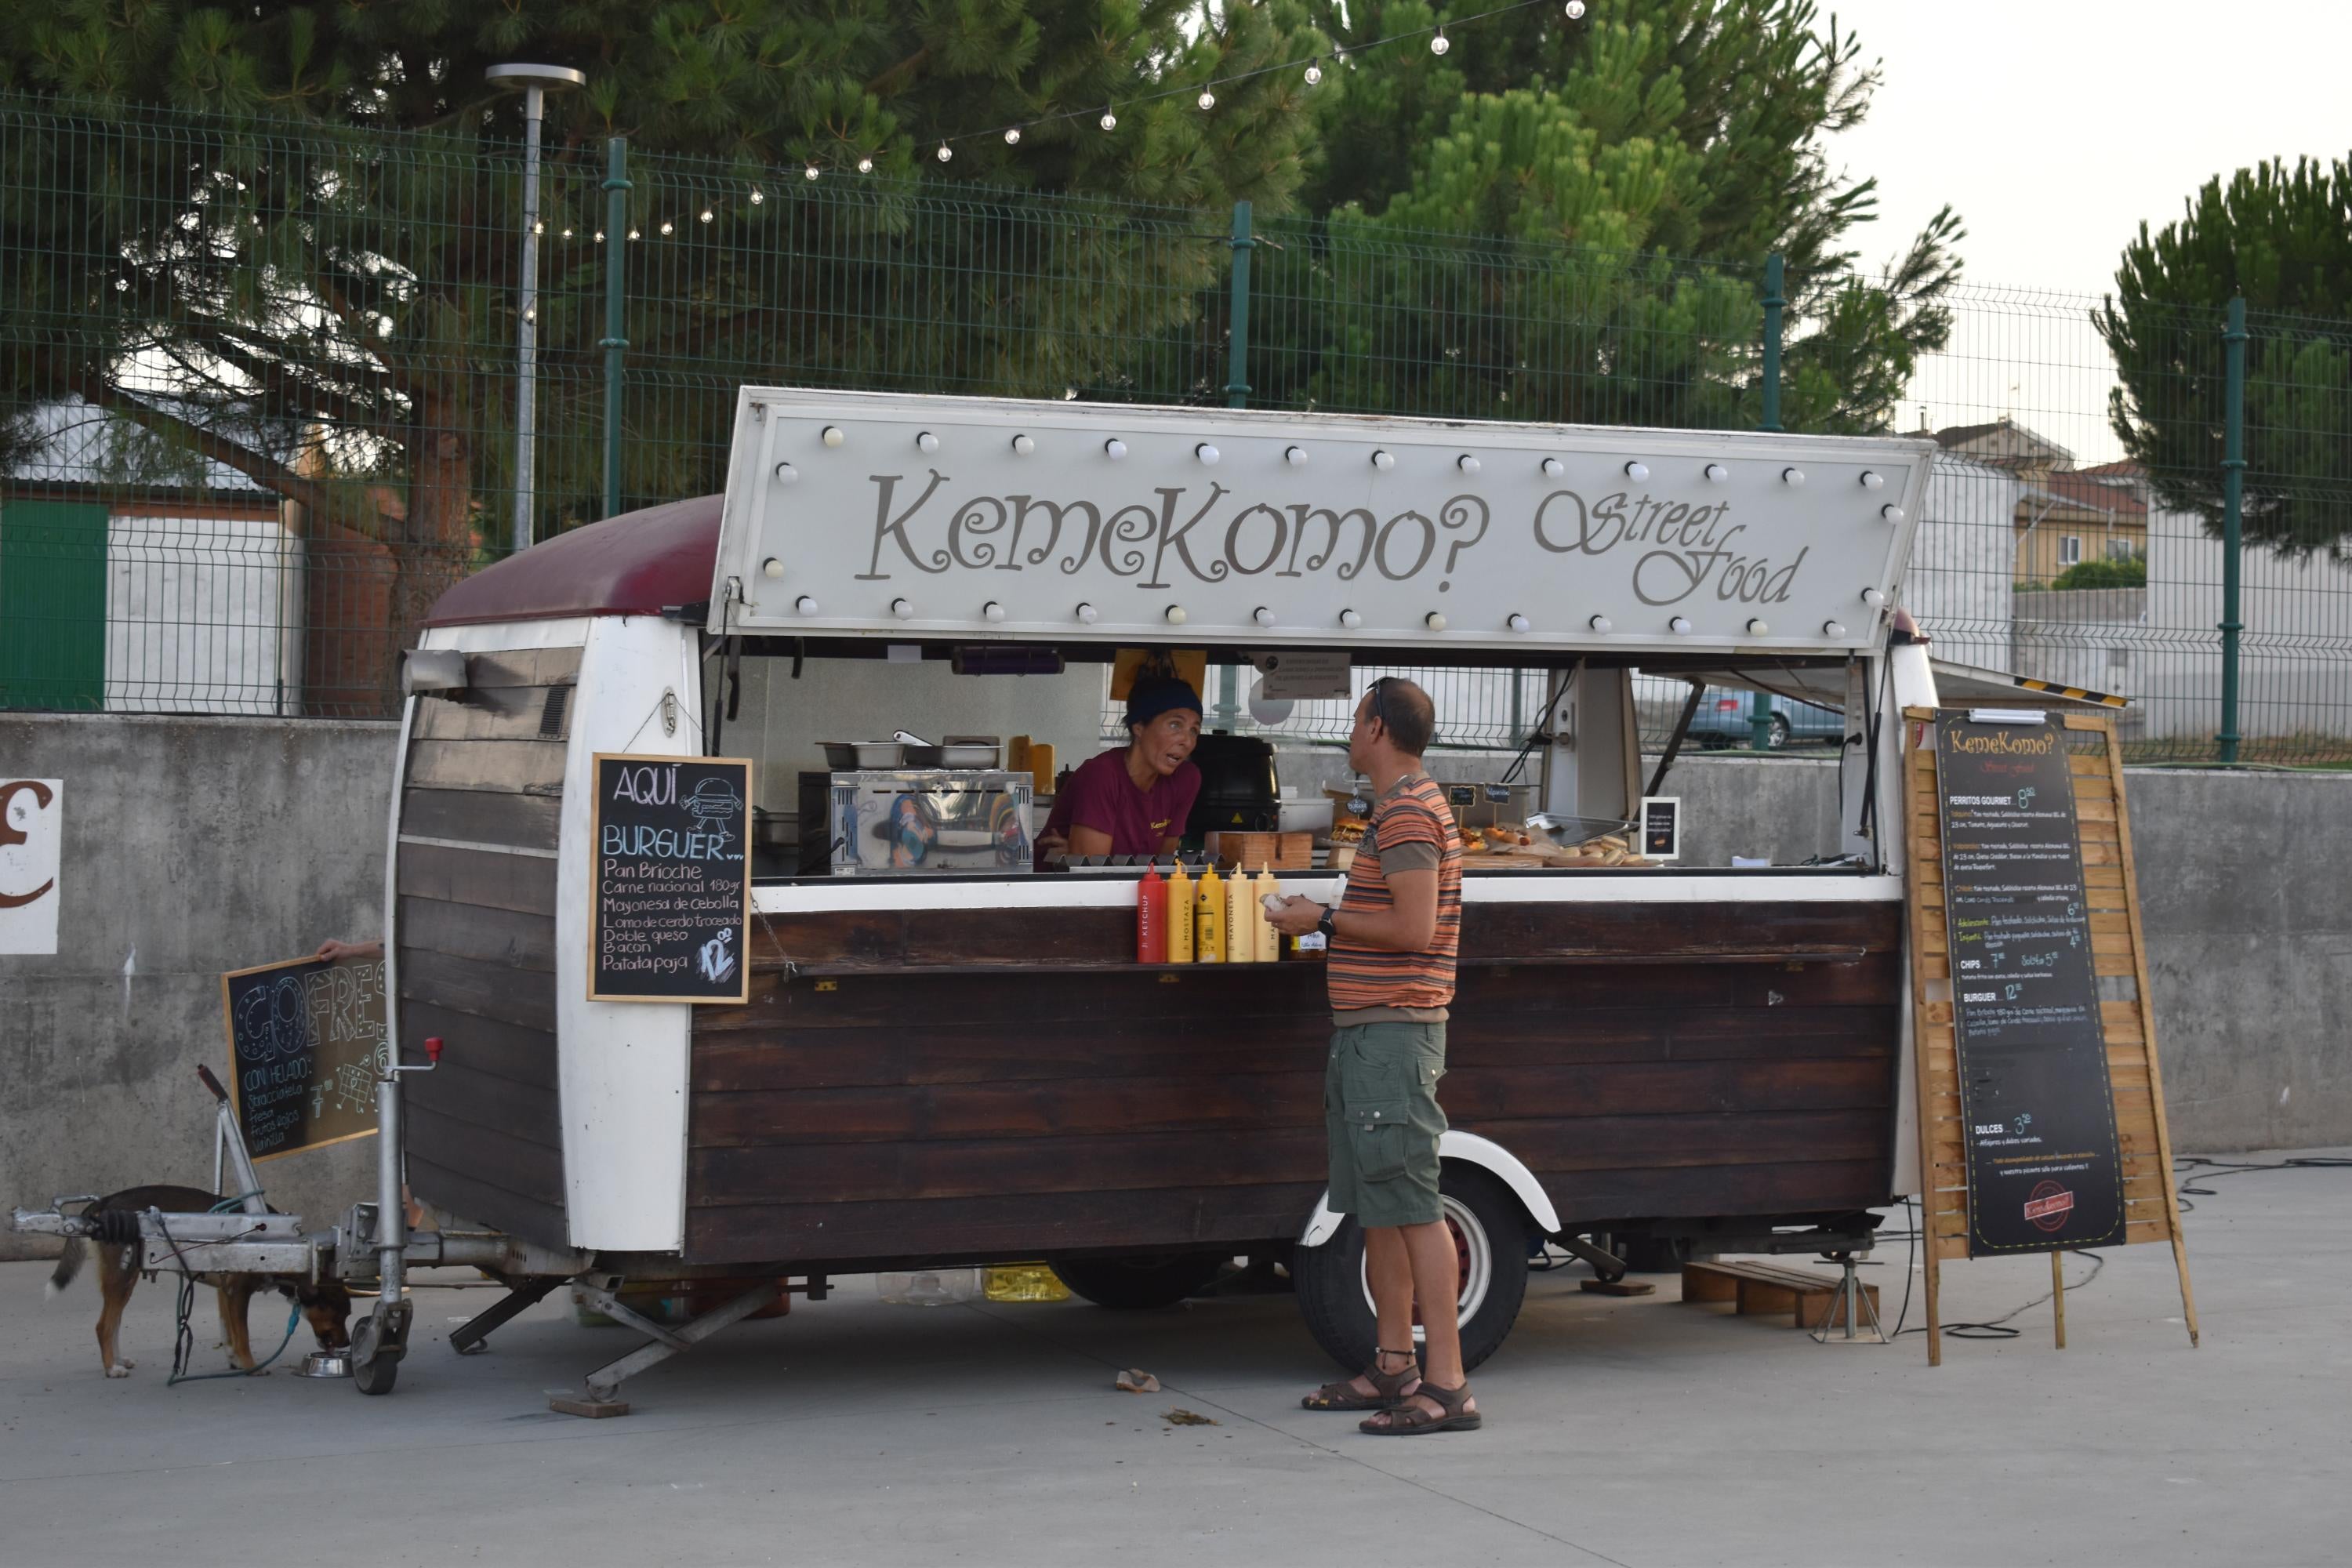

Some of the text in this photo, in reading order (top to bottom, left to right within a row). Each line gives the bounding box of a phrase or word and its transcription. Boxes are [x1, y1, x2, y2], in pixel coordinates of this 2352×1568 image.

[854, 468, 1490, 593] KemeKomo?
[1534, 490, 1809, 607] Street Food
[1951, 730, 2055, 755] KemeKomo?
[613, 763, 683, 806] AQUÍ
[1950, 796, 1980, 805] PERRITOS
[1981, 796, 2012, 805] GOURMET
[602, 825, 725, 861] BURGUER
[604, 858, 702, 880] Pan Brioche
[602, 880, 644, 894] Carne
[648, 880, 704, 893] nacional
[603, 894, 739, 916] Mayonesa de cebolla
[603, 913, 743, 929] Lomo de cerdo troceado
[603, 929, 647, 942] Doble
[652, 930, 688, 946] queso
[603, 942, 652, 953] Bacon
[602, 955, 688, 974] Patata paja
[1960, 960, 1981, 970] CHIPS
[1964, 993, 1997, 1002] BURGUER
[244, 1067, 266, 1092] CON
[249, 1109, 274, 1123] Fresa
[1976, 1123, 2003, 1134] DULCES
